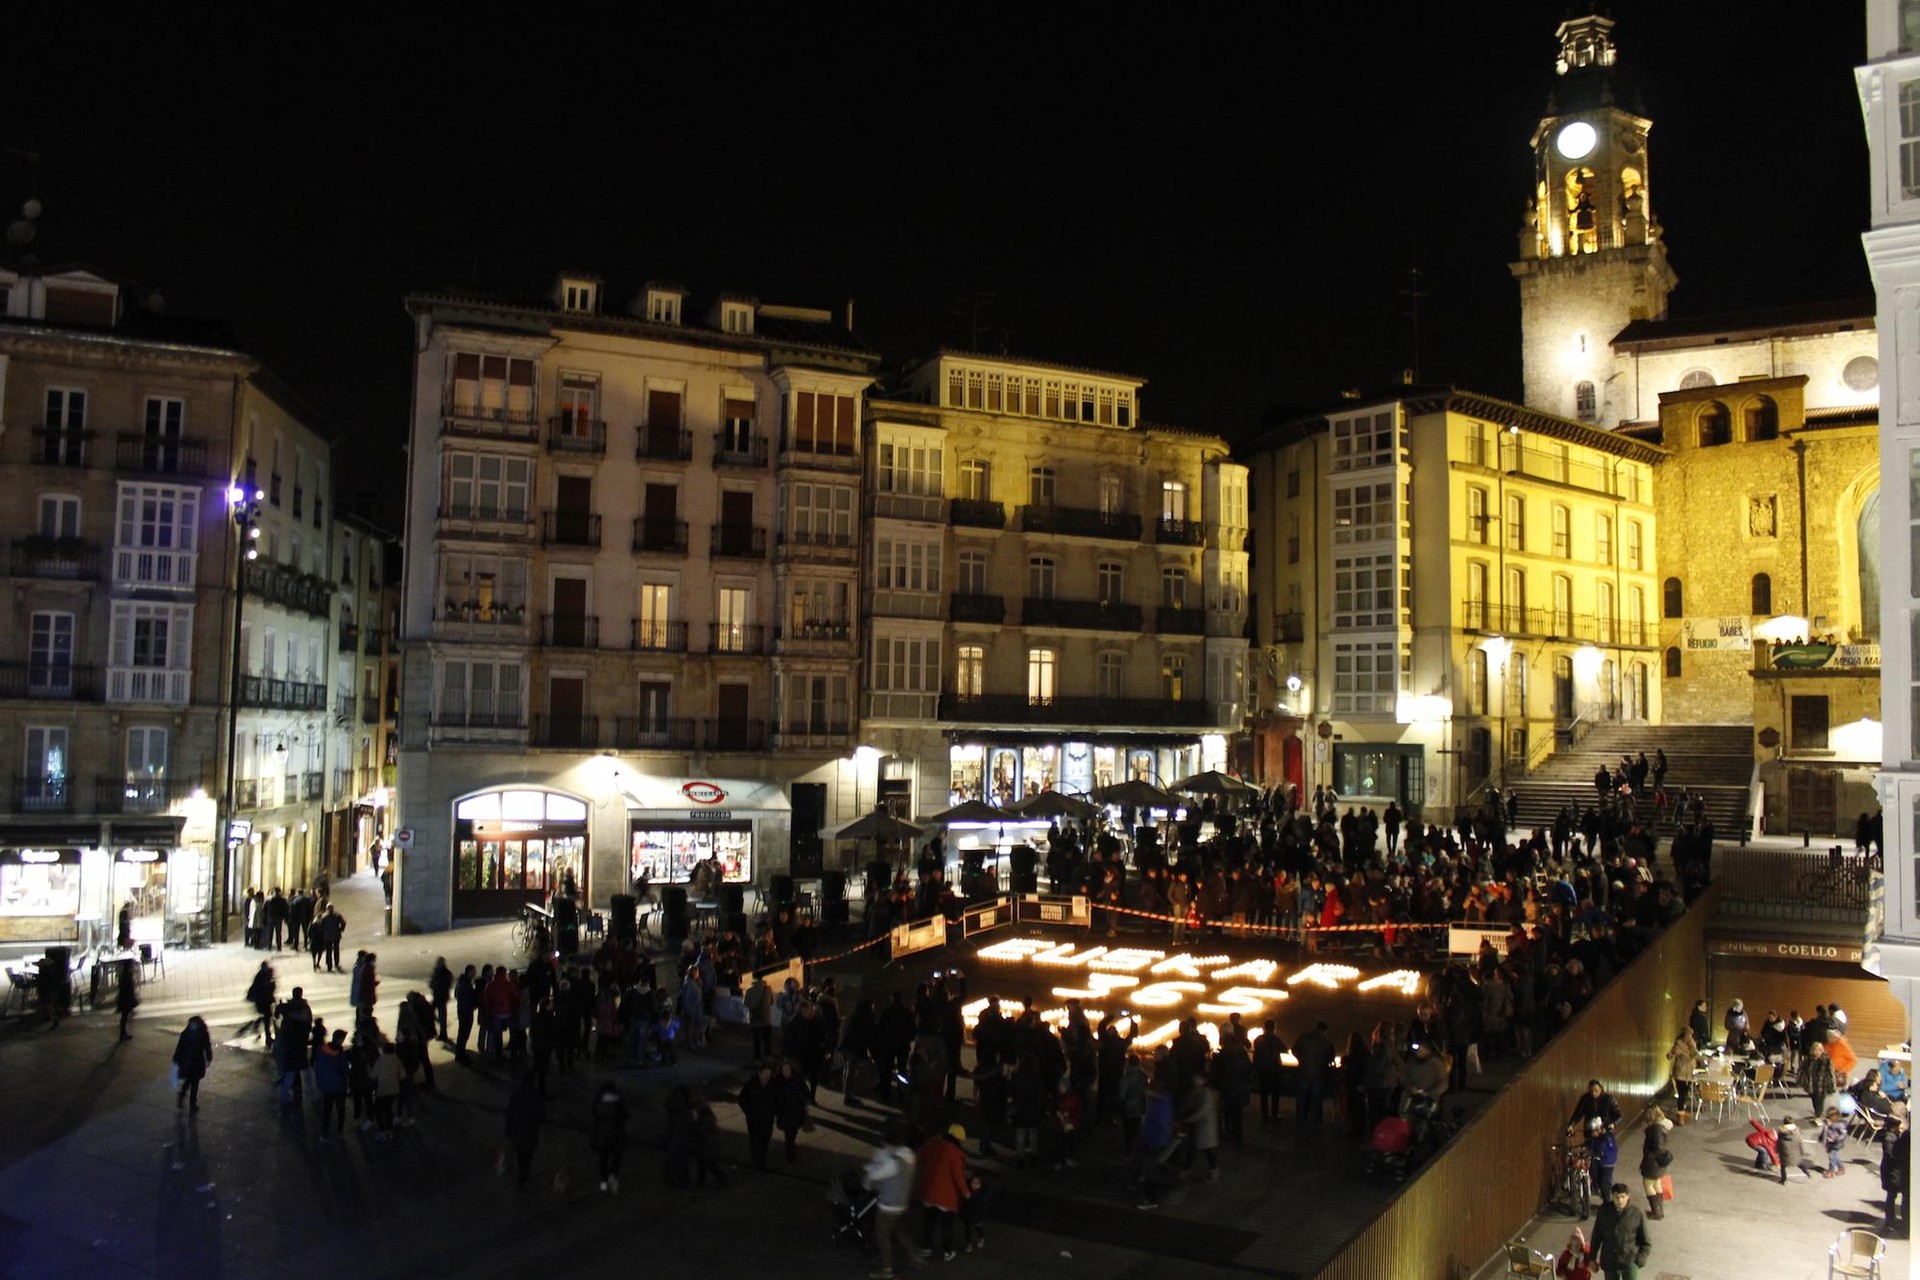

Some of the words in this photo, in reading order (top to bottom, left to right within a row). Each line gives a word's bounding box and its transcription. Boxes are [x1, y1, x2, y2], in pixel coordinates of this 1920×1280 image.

[1720, 626, 1743, 637] BABES
[1687, 639, 1717, 649] REFUGIO
[1833, 656, 1862, 667] MEDIA
[1863, 656, 1882, 666] MA
[1778, 944, 1838, 958] COELLO
[1051, 972, 1290, 1015] 365
